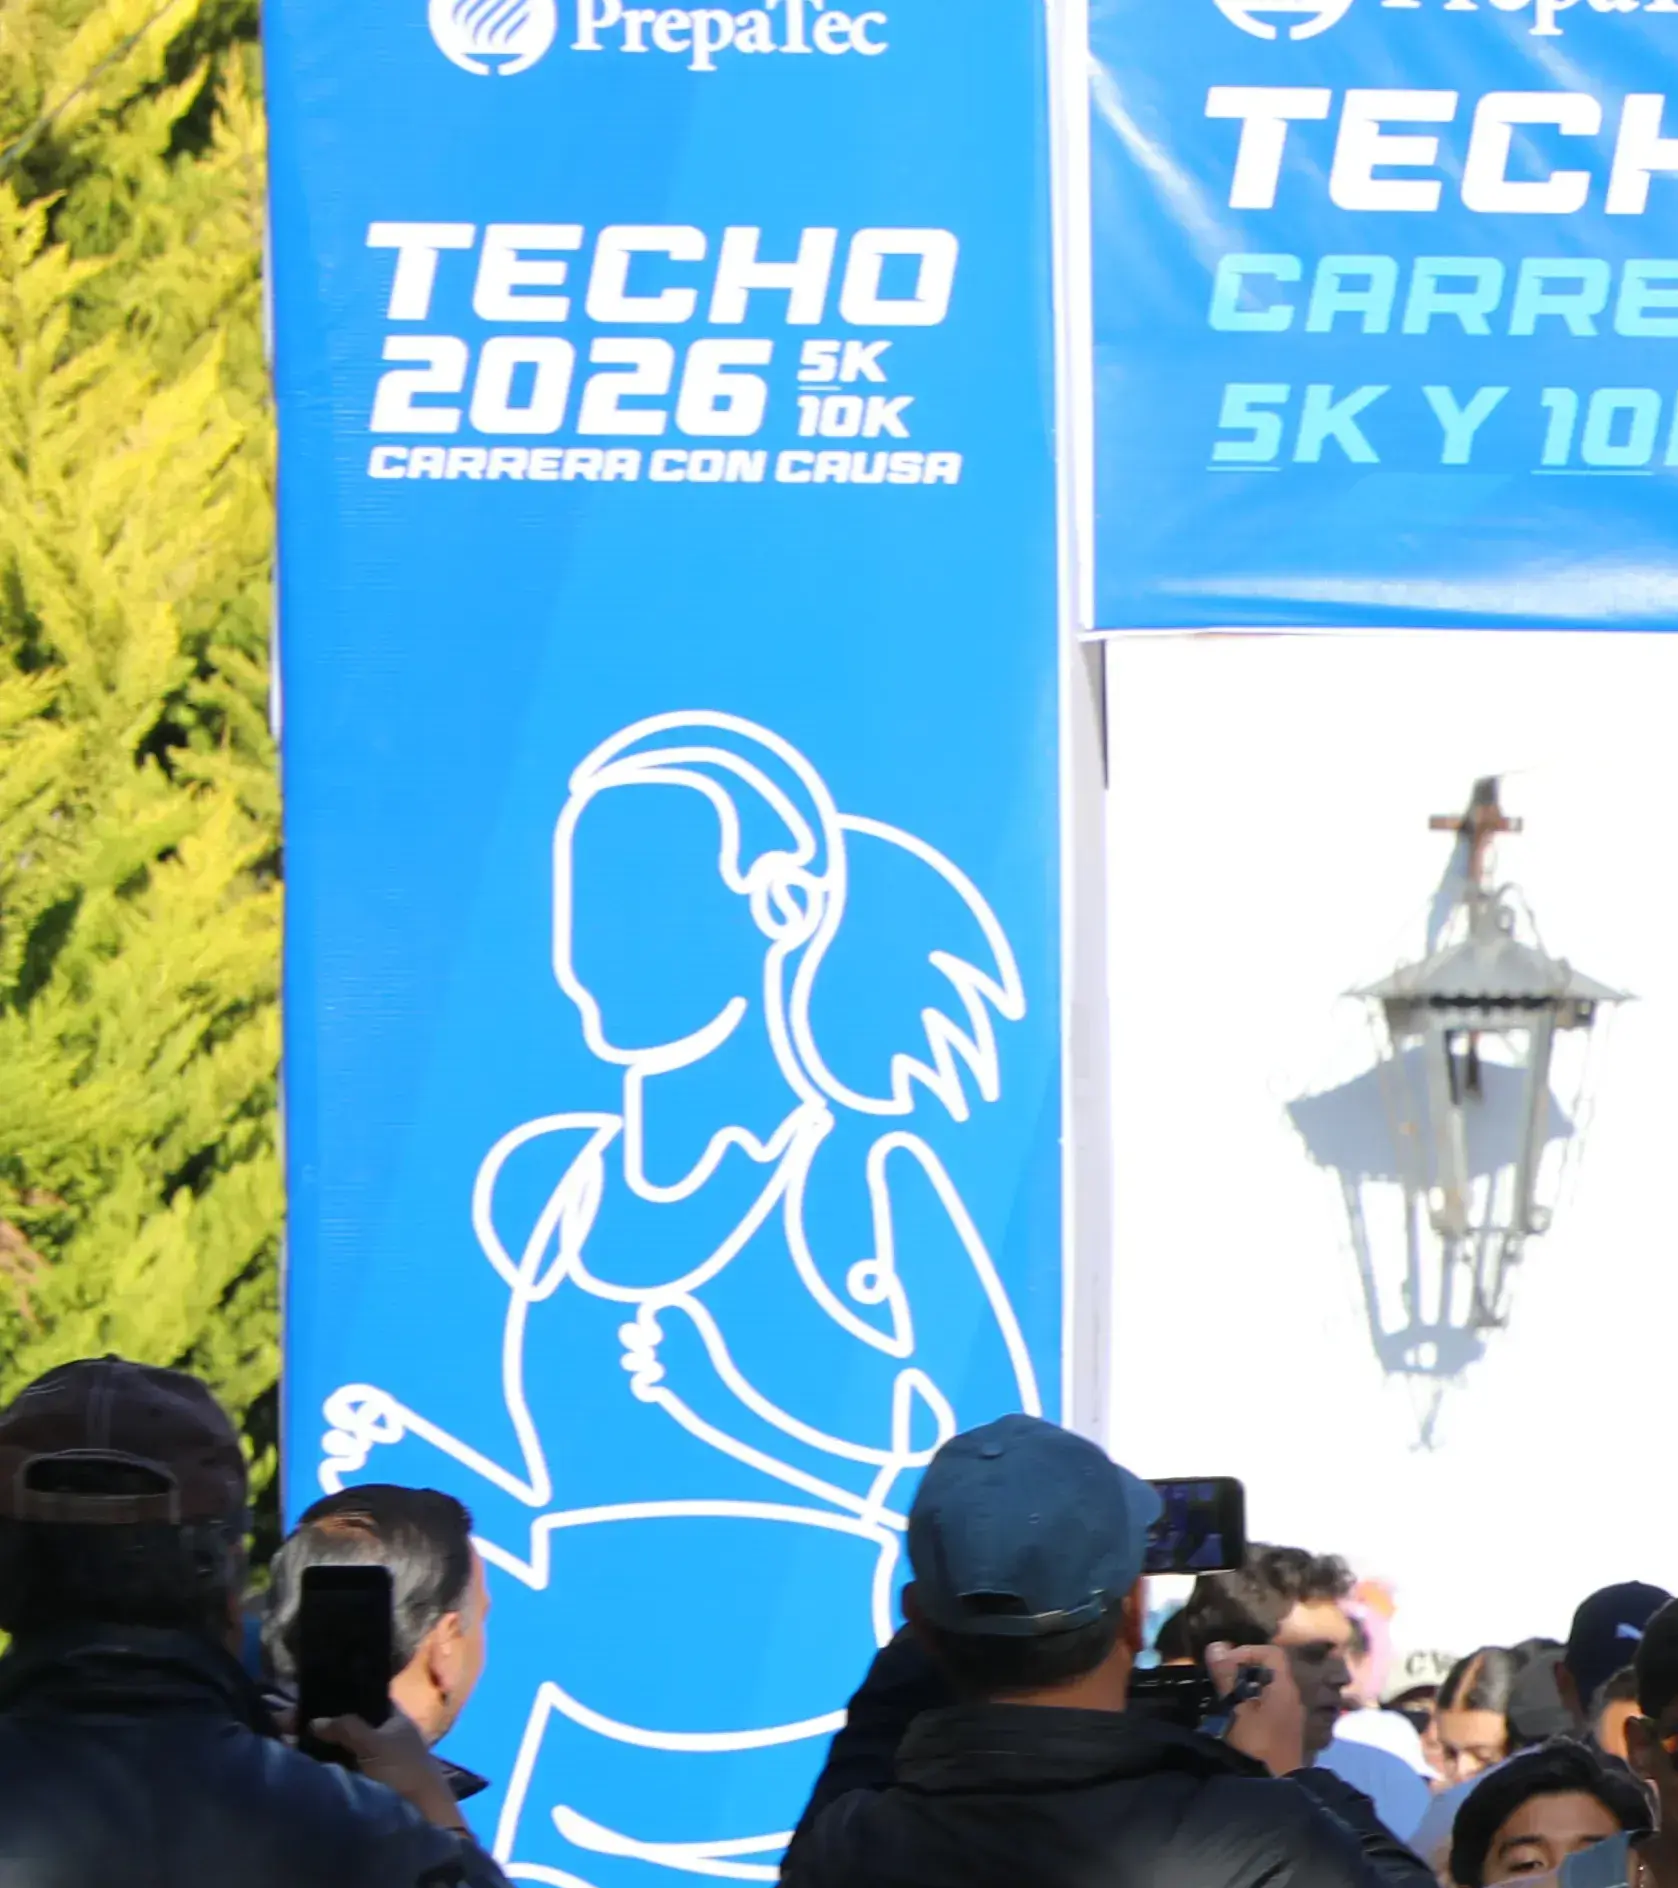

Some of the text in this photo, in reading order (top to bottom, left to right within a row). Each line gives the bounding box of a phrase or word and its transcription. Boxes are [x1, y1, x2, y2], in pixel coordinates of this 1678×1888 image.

[570, 0, 888, 71] PrepaTec
[366, 222, 959, 327] TECHO
[369, 335, 774, 437] 2026
[797, 340, 893, 384] 5K
[797, 395, 914, 438] 10K
[1211, 382, 1389, 464] 5K
[1422, 385, 1510, 465] Y
[367, 446, 963, 485] CARRERA CON CAUSA
